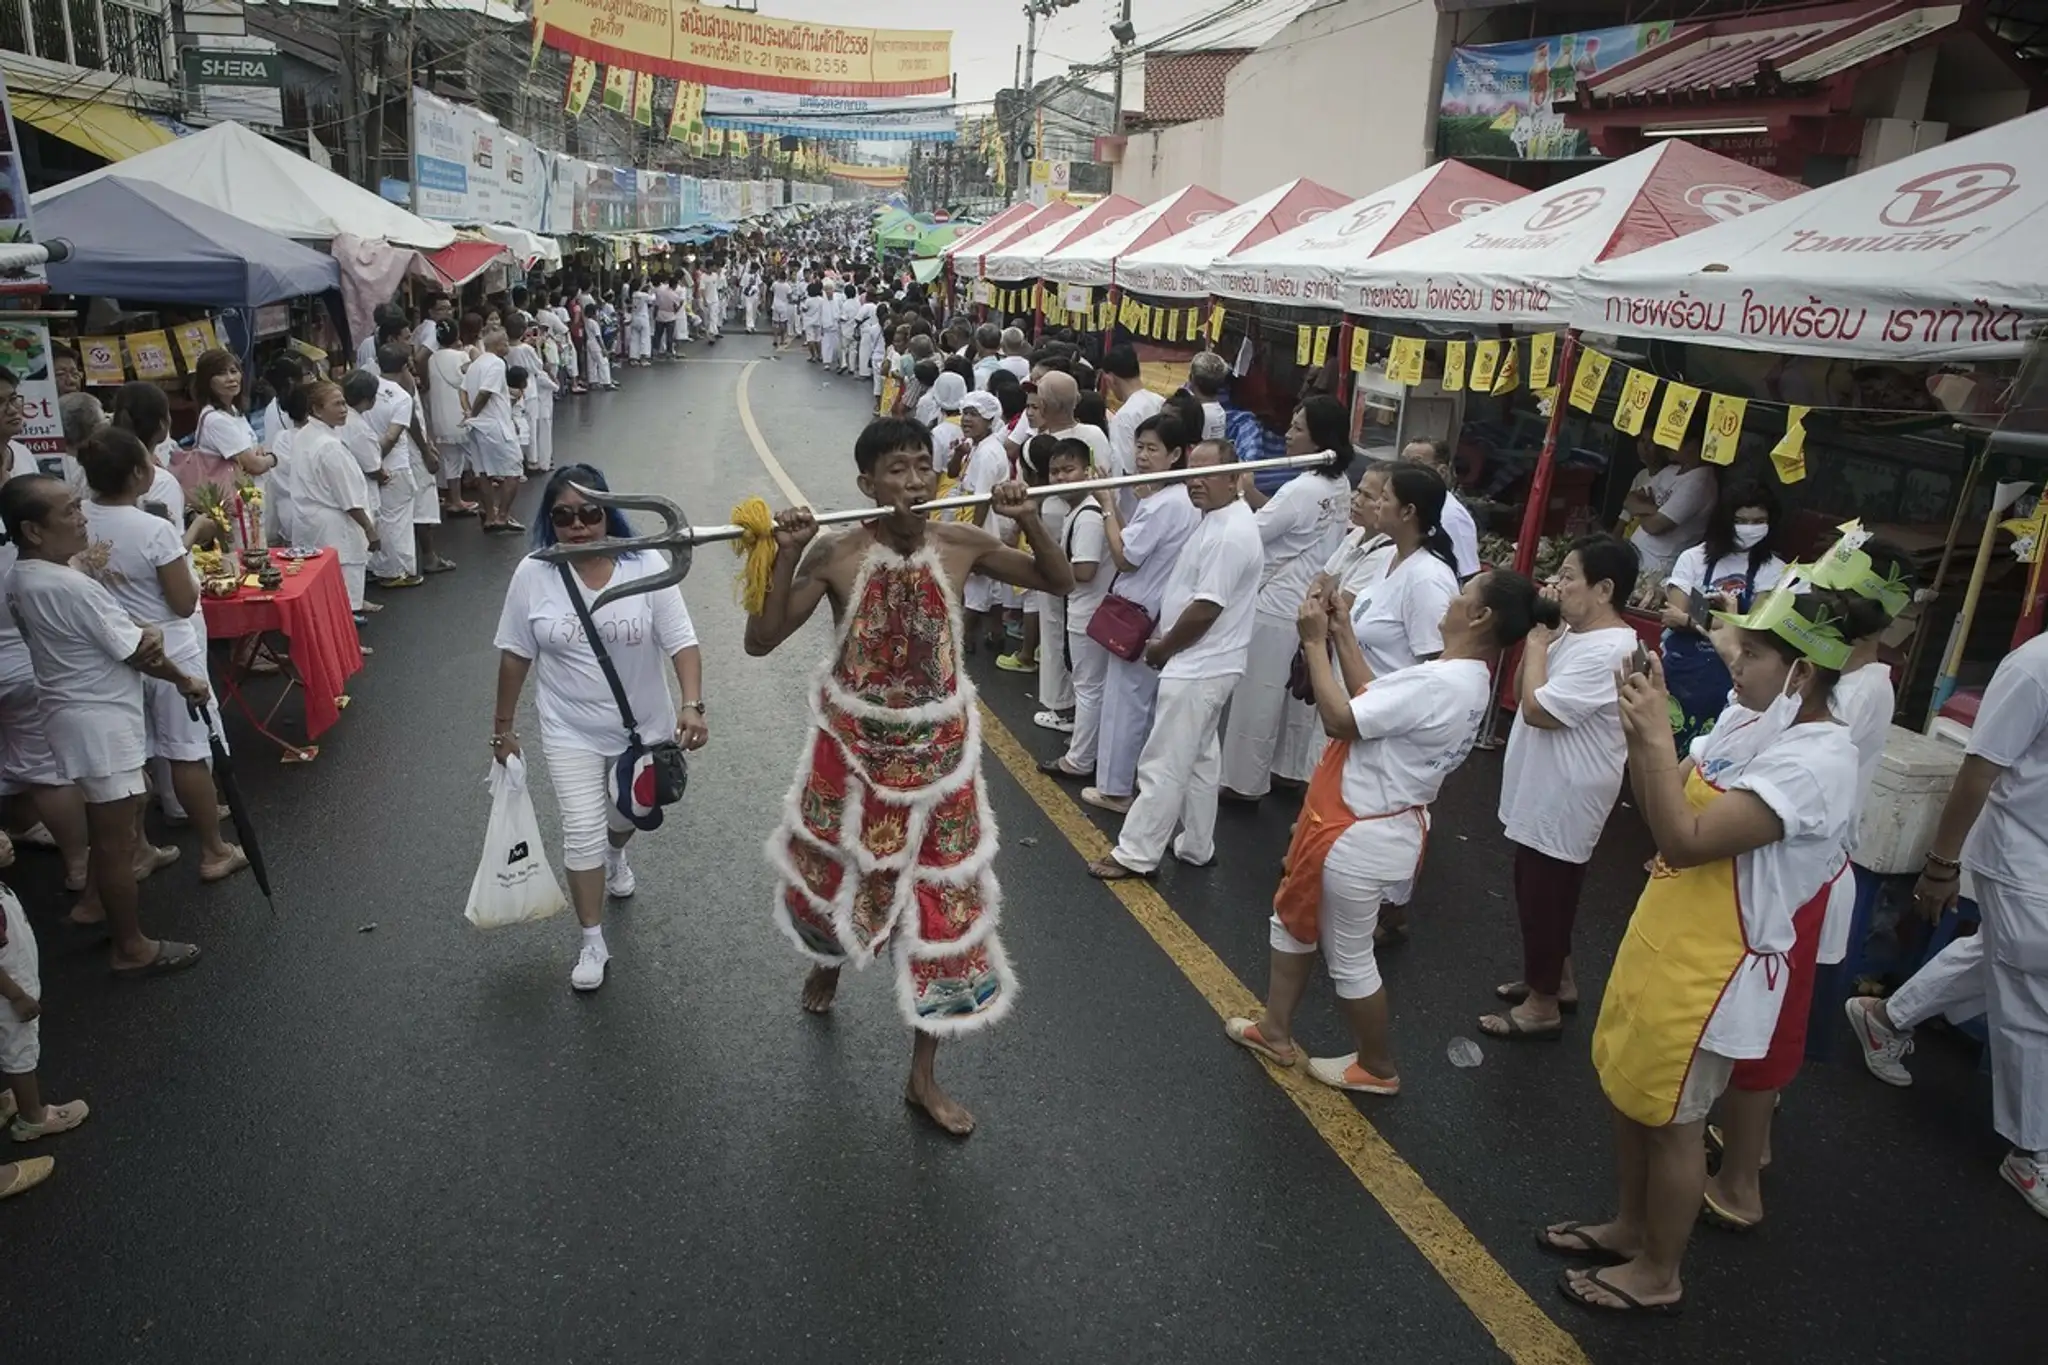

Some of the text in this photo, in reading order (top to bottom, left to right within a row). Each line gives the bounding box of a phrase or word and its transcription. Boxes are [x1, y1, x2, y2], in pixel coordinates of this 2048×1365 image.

[201, 58, 268, 78] SHERA
[1360, 281, 1420, 310] กายพร้อม
[1425, 278, 1483, 311] ใจพร้อม
[1605, 288, 2024, 343] กายพร้อม ใจพร้อม เราทำได้
